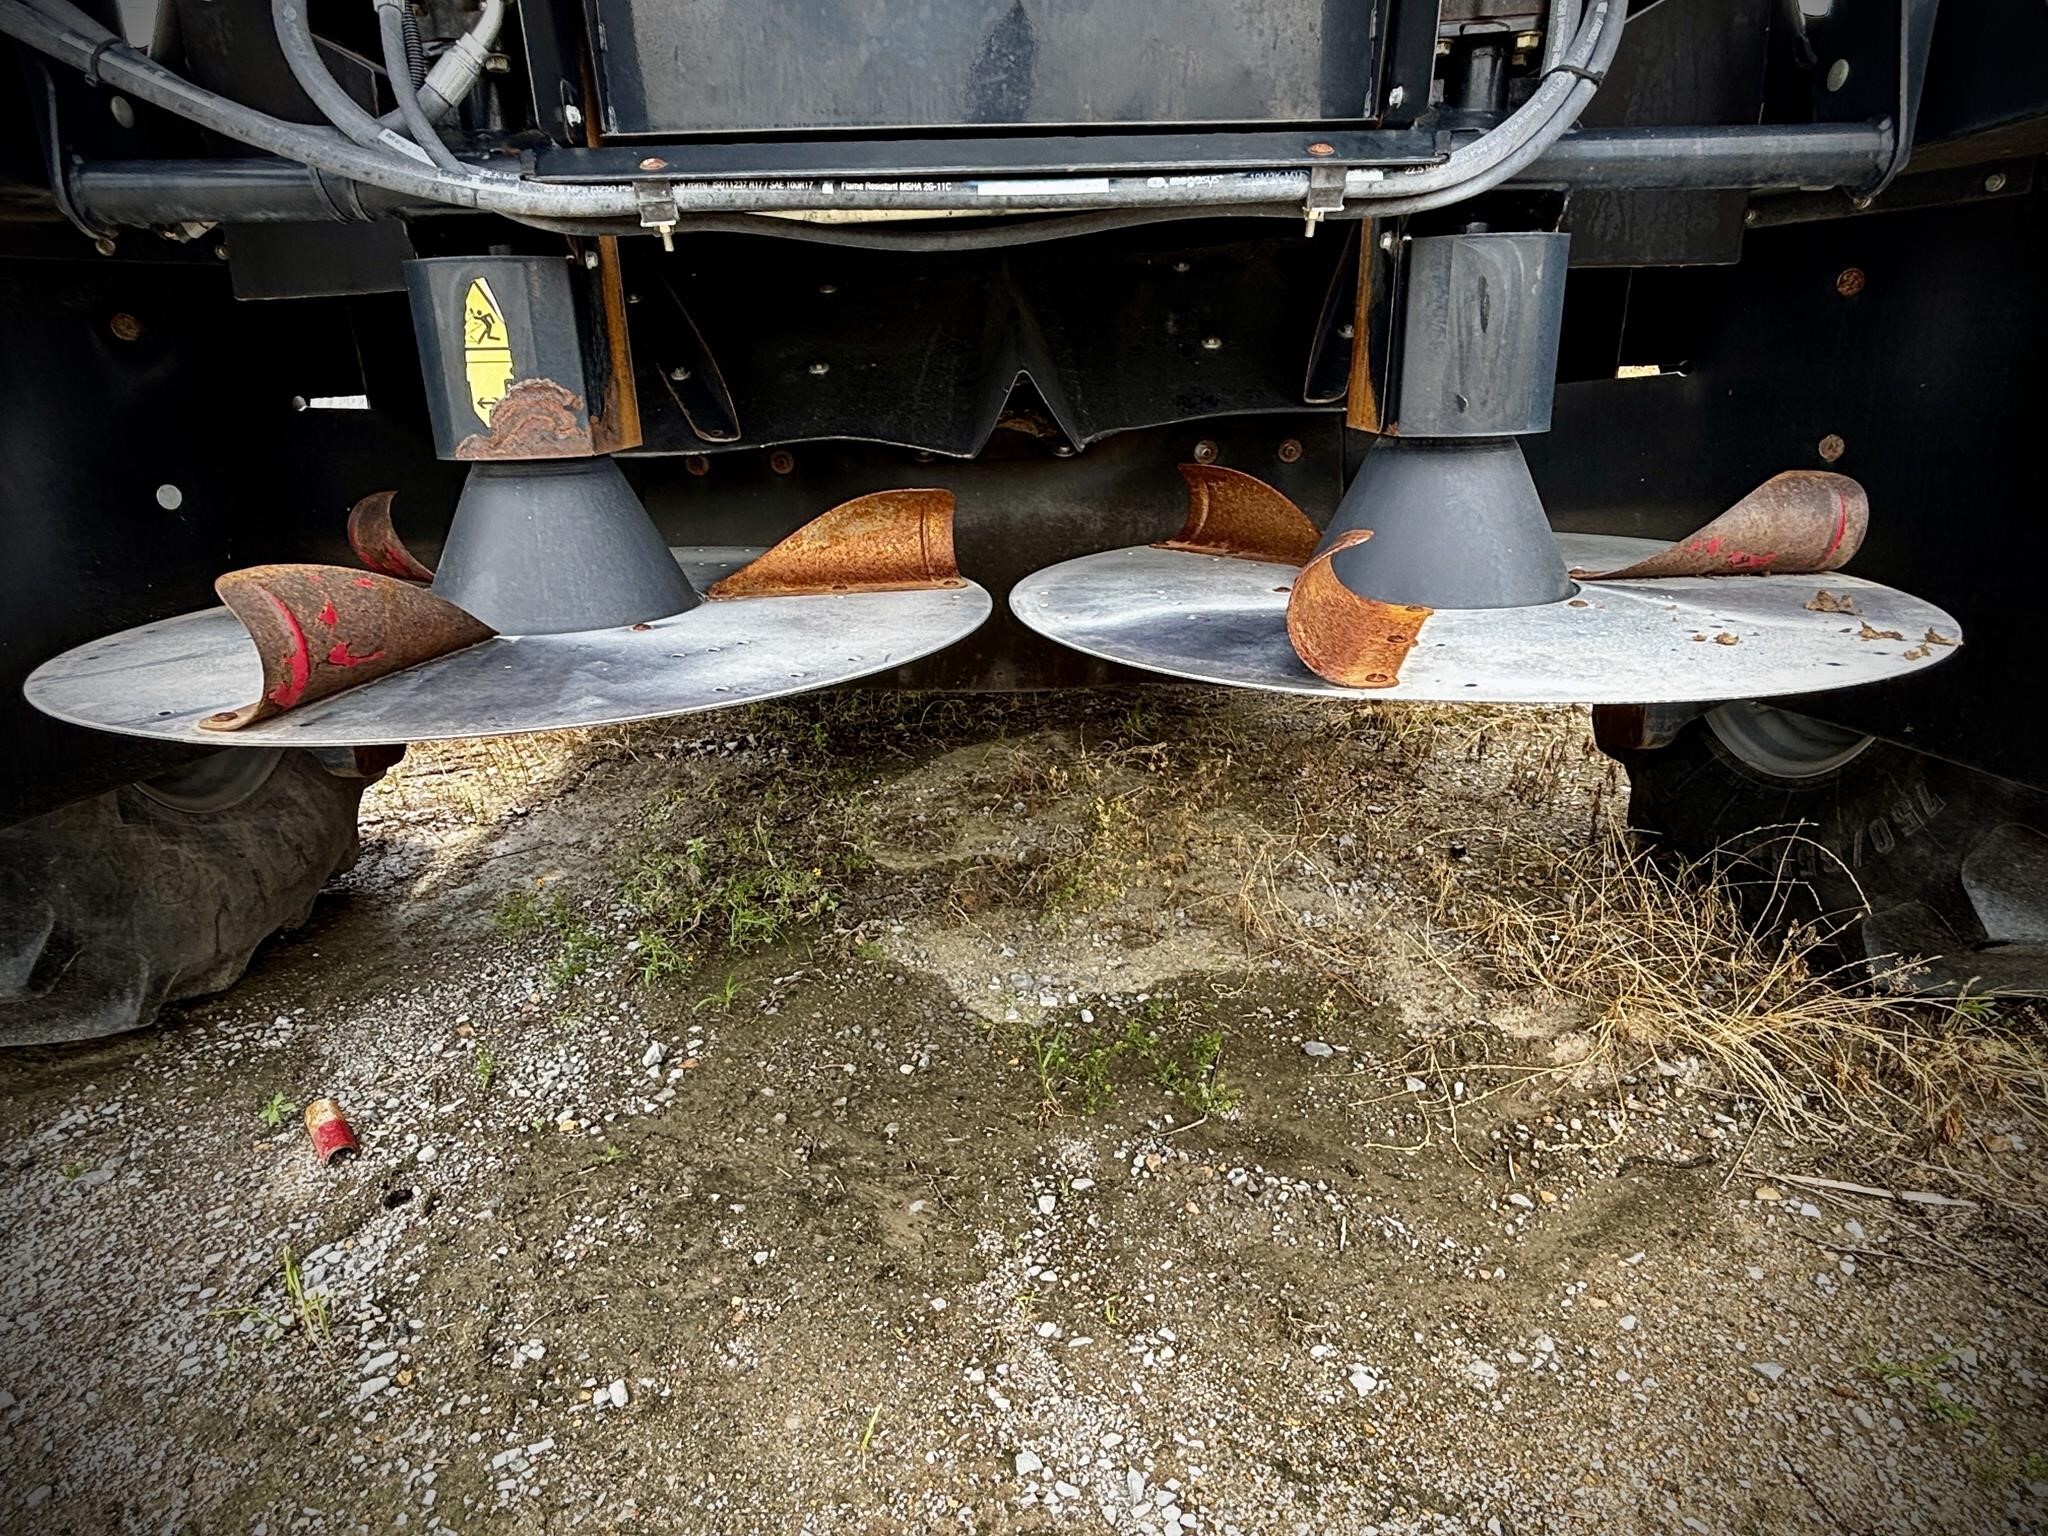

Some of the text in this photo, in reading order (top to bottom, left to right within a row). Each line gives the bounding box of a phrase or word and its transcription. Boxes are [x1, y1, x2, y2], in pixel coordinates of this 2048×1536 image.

[769, 180, 785, 190] SAE
[841, 181, 864, 191] Flame
[865, 181, 898, 191] Resistant
[899, 181, 922, 191] MSHA
